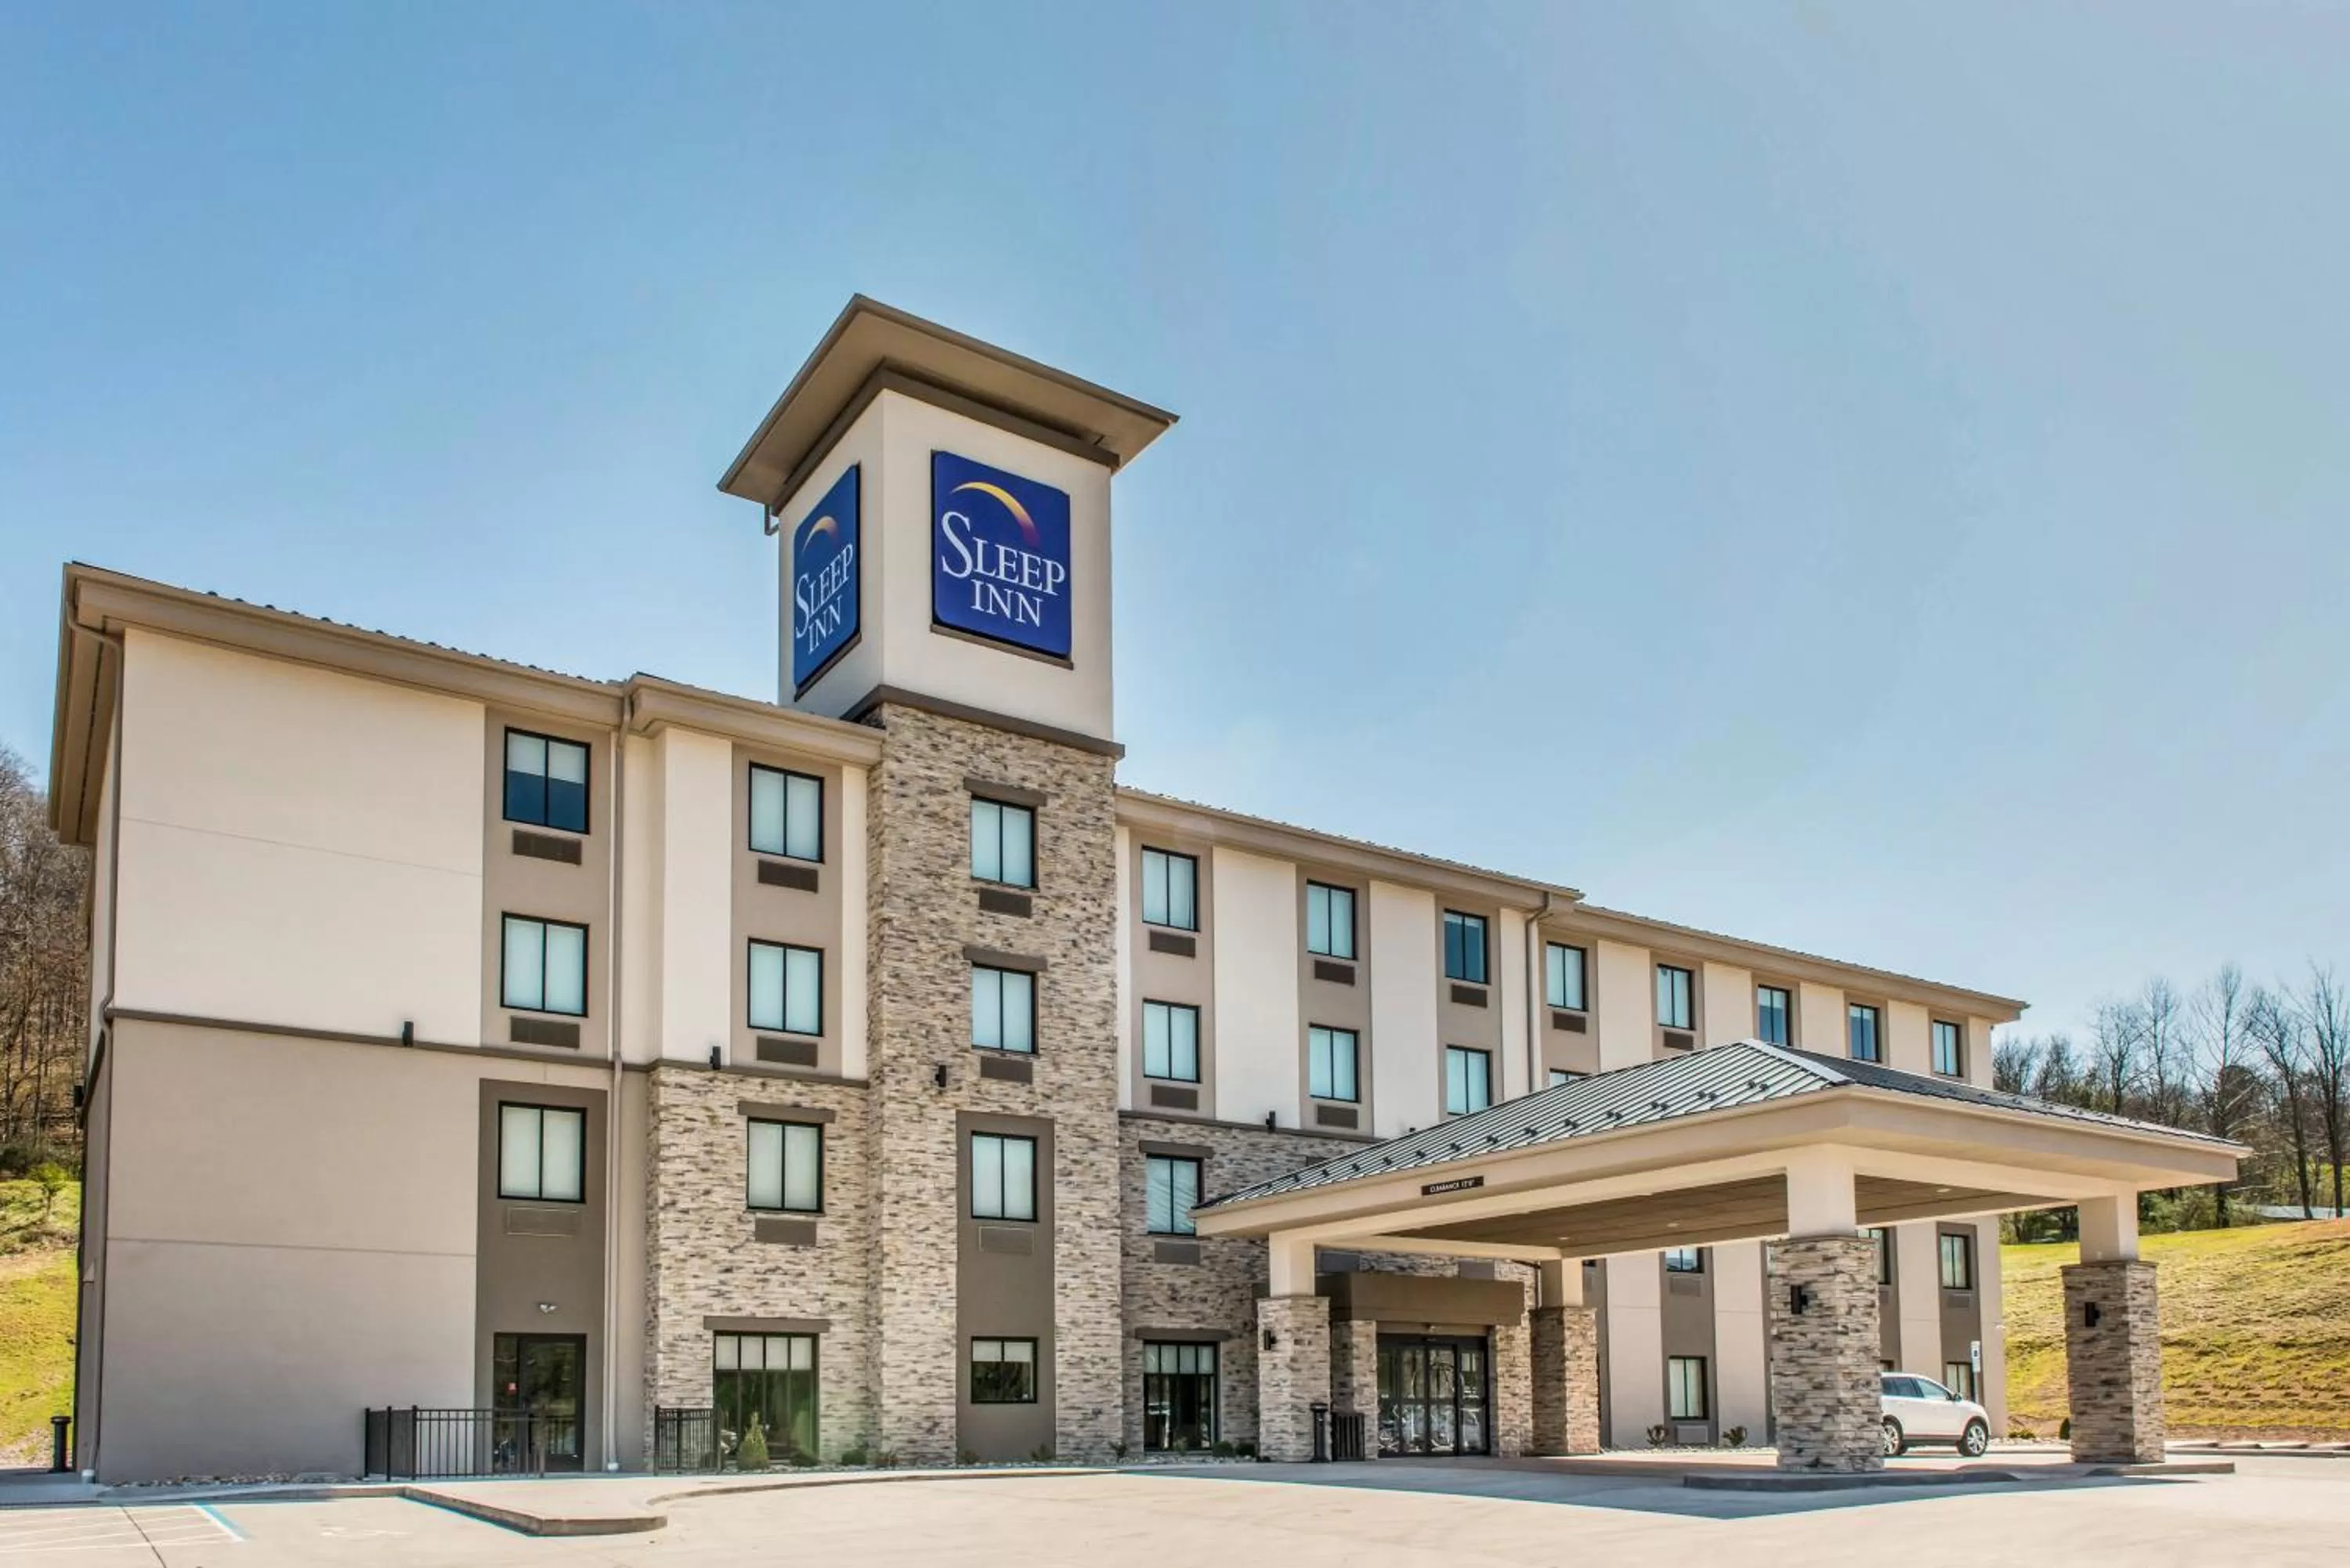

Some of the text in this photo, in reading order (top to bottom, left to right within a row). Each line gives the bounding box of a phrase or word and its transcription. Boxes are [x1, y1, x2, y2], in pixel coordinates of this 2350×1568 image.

[942, 511, 1065, 596] SLEEP
[795, 543, 853, 639] SLEEP
[808, 595, 843, 655] INN
[971, 578, 1044, 627] INN
